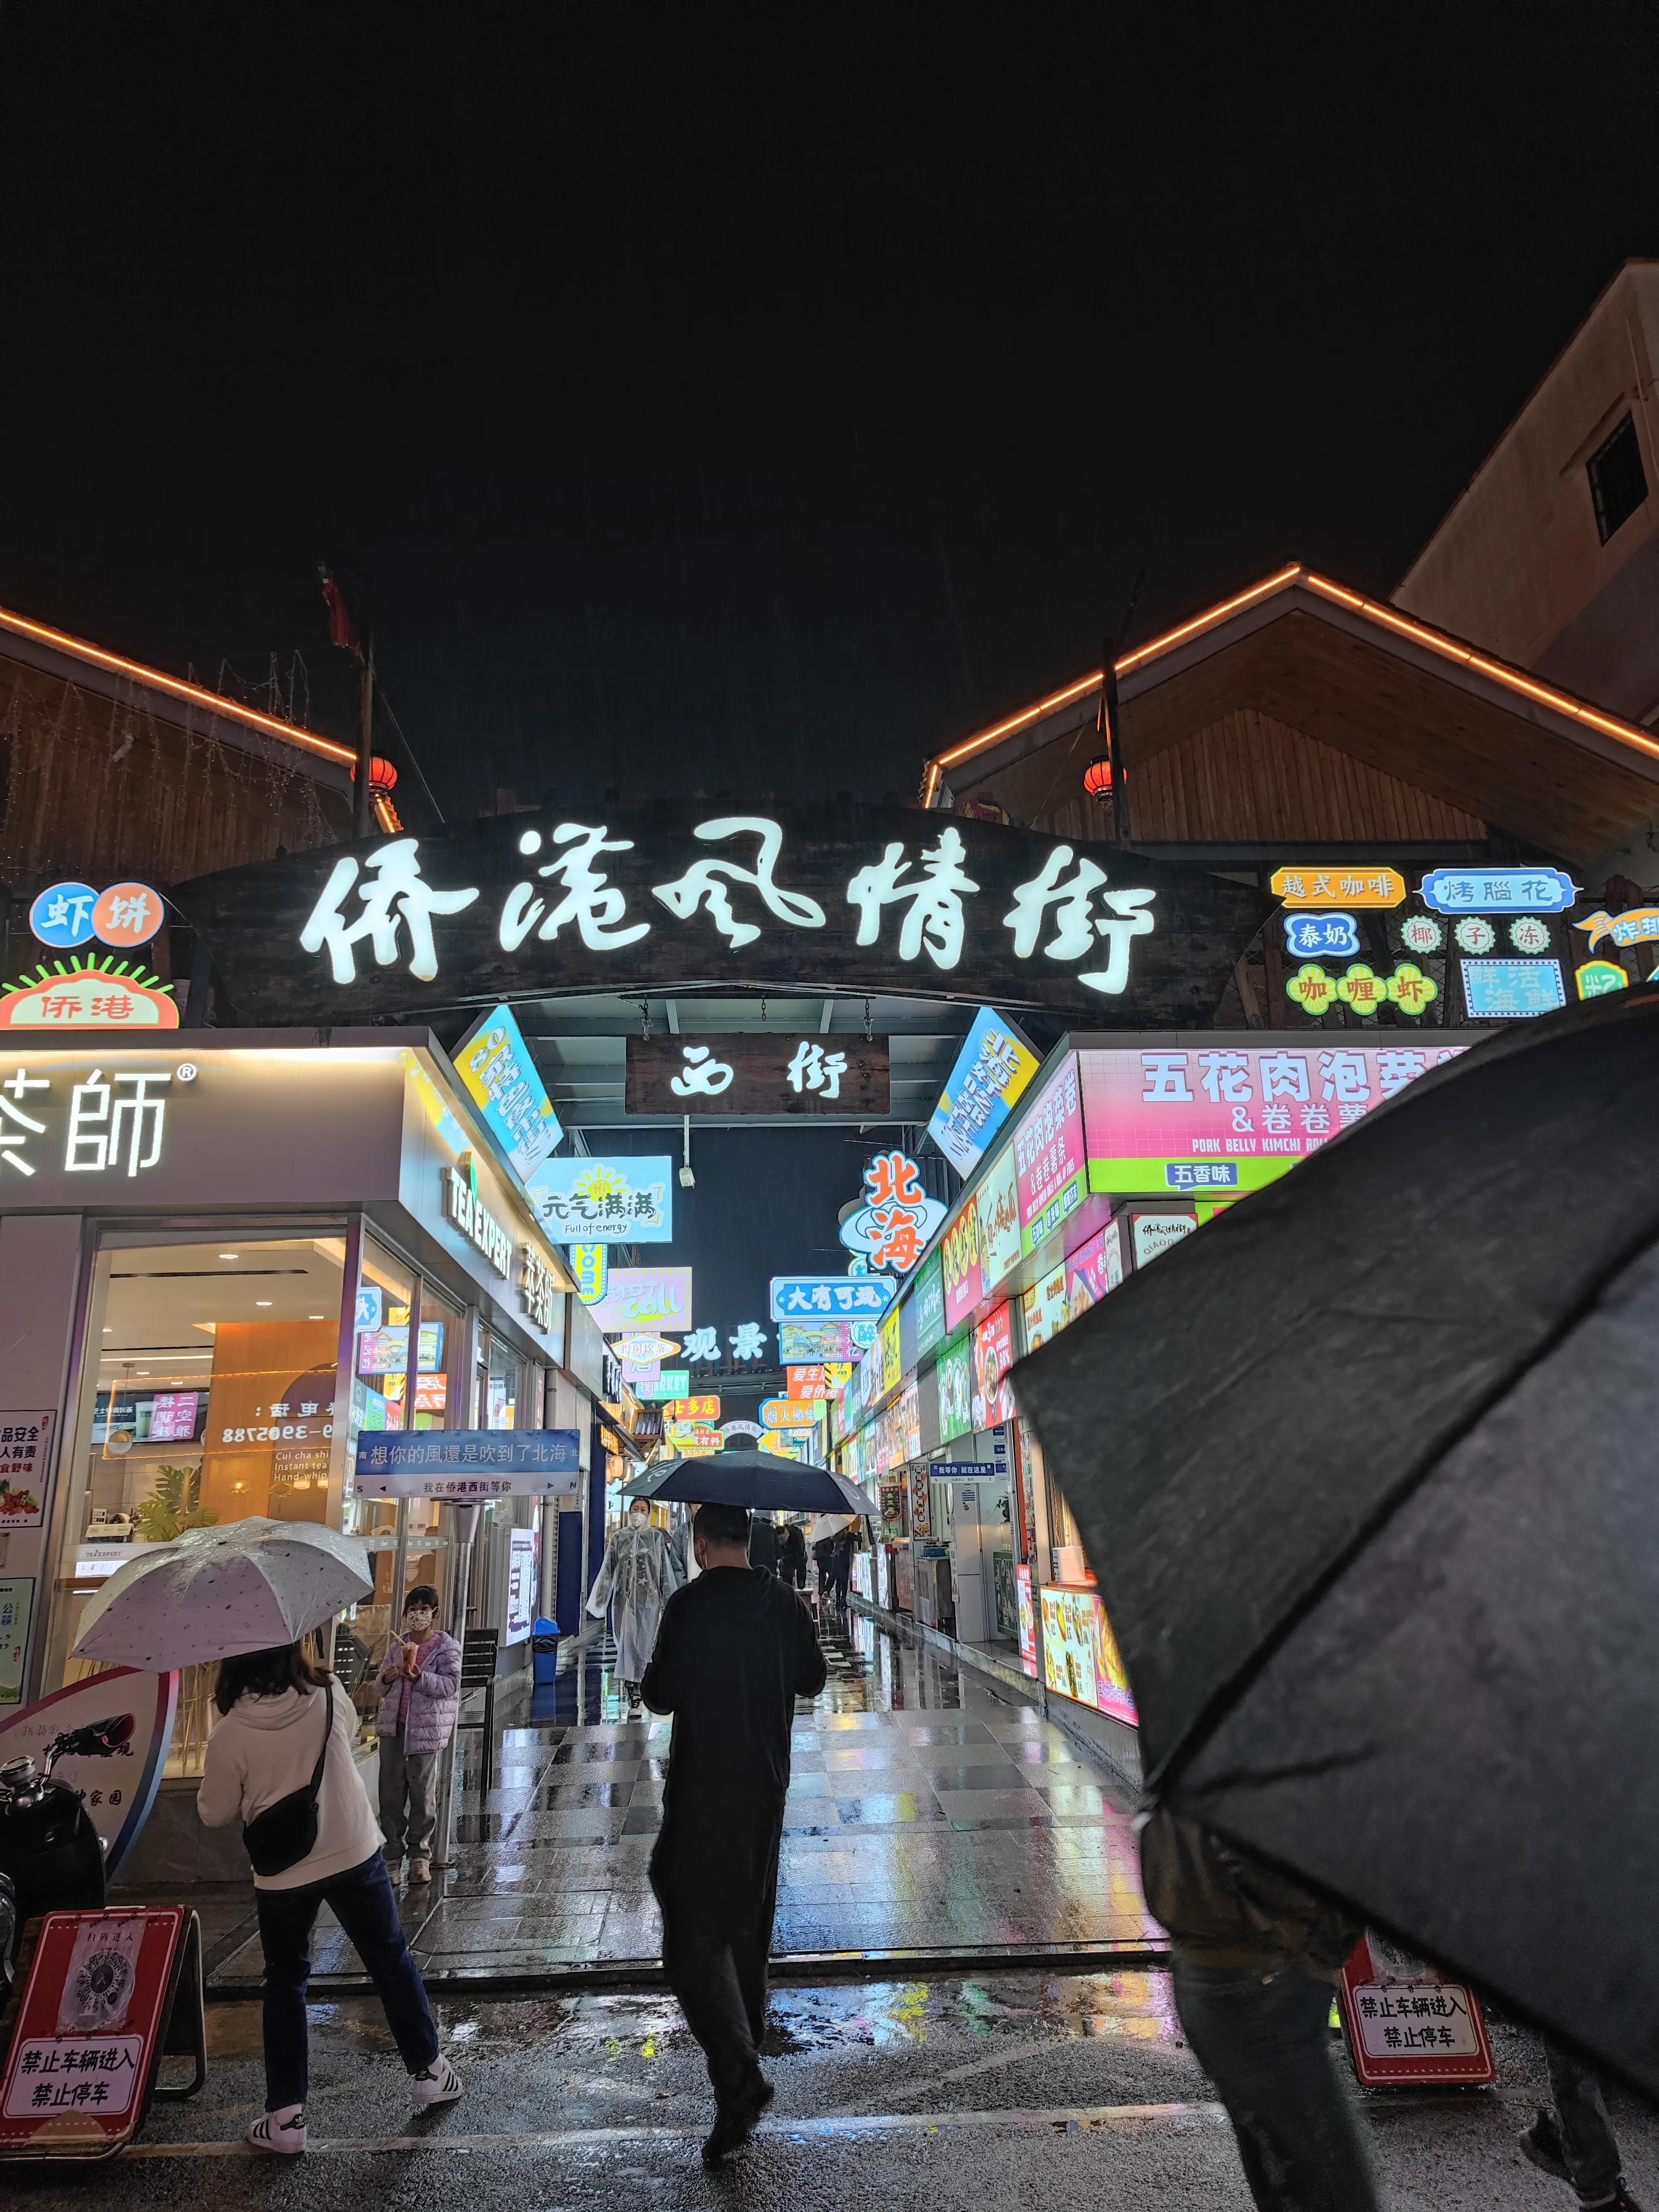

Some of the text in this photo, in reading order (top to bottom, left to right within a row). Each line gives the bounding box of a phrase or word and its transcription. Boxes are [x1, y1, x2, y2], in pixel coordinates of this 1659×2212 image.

[1281, 874, 1394, 899] 越式咖啡
[41, 892, 151, 937] 虾饼
[300, 816, 1155, 994] 侨港风情街
[1298, 923, 1348, 947] 泰奶
[1411, 927, 1540, 946] 椰子冻
[1299, 976, 1424, 1003] 咖喱虾
[42, 995, 135, 1019] 侨港
[671, 1041, 847, 1099] 西街
[1140, 1051, 1464, 1103] 五花肉泡菜
[1017, 1069, 1077, 1175] 五花肉泡菜卷
[1192, 1138, 1328, 1153] PORK BELLY KIMCHI RO
[1173, 1165, 1232, 1184] 五香味
[542, 1192, 656, 1219] 元气满满
[869, 1155, 924, 1270] 北海
[447, 1167, 513, 1280] TEA EXPERT
[565, 1223, 627, 1234] Full of energy
[787, 1284, 882, 1311] 大有可玩
[621, 1344, 666, 1354] 得闲饮茶
[680, 1322, 768, 1362] 观景
[0, 1426, 40, 1443] 品安全
[275, 1450, 329, 1461] Cui cha shi
[370, 1443, 567, 1465] 想你的風還是吹到了北海
[274, 1462, 310, 1471] Instant
[938, 1466, 957, 1474] 我等你
[423, 1481, 512, 1493] 我在侨港西街等你
[570, 1481, 577, 1489] N
[86, 1931, 134, 1943] 扫码进入
[1359, 1995, 1467, 2018] 禁止车辆进入
[1384, 2025, 1456, 2049] 禁止停车
[21, 2047, 136, 2074] 禁止车辆进入
[31, 2081, 111, 2108] 禁止停车
